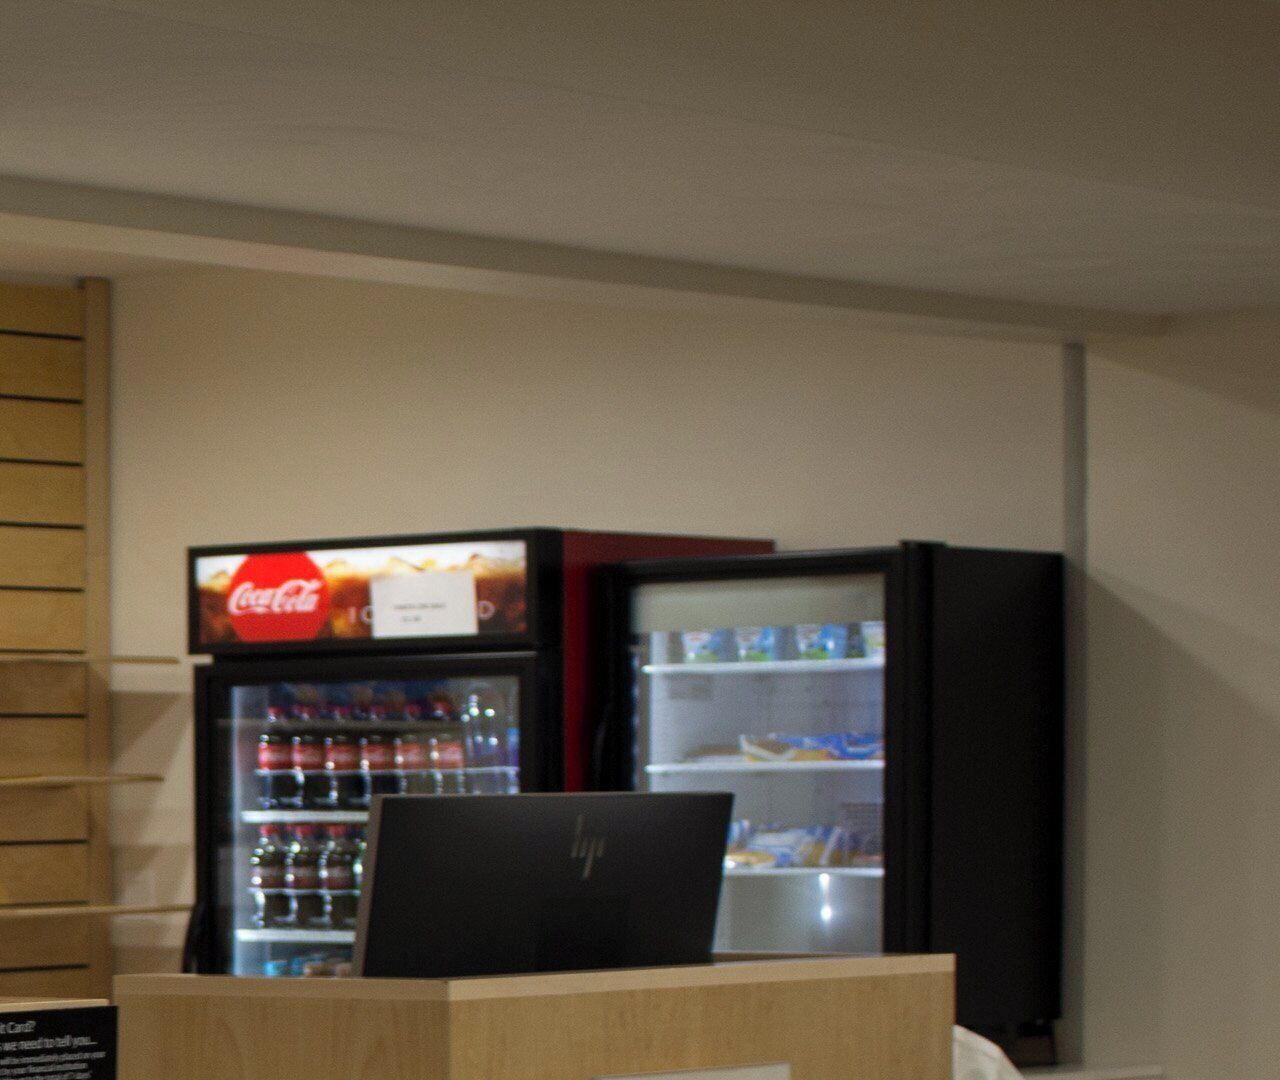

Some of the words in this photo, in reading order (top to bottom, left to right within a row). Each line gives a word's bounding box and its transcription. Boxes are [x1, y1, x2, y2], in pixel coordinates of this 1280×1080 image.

[6, 1021, 36, 1034] Card?
[3, 1042, 17, 1052] we
[18, 1038, 42, 1050] need
[54, 1034, 71, 1048] tell
